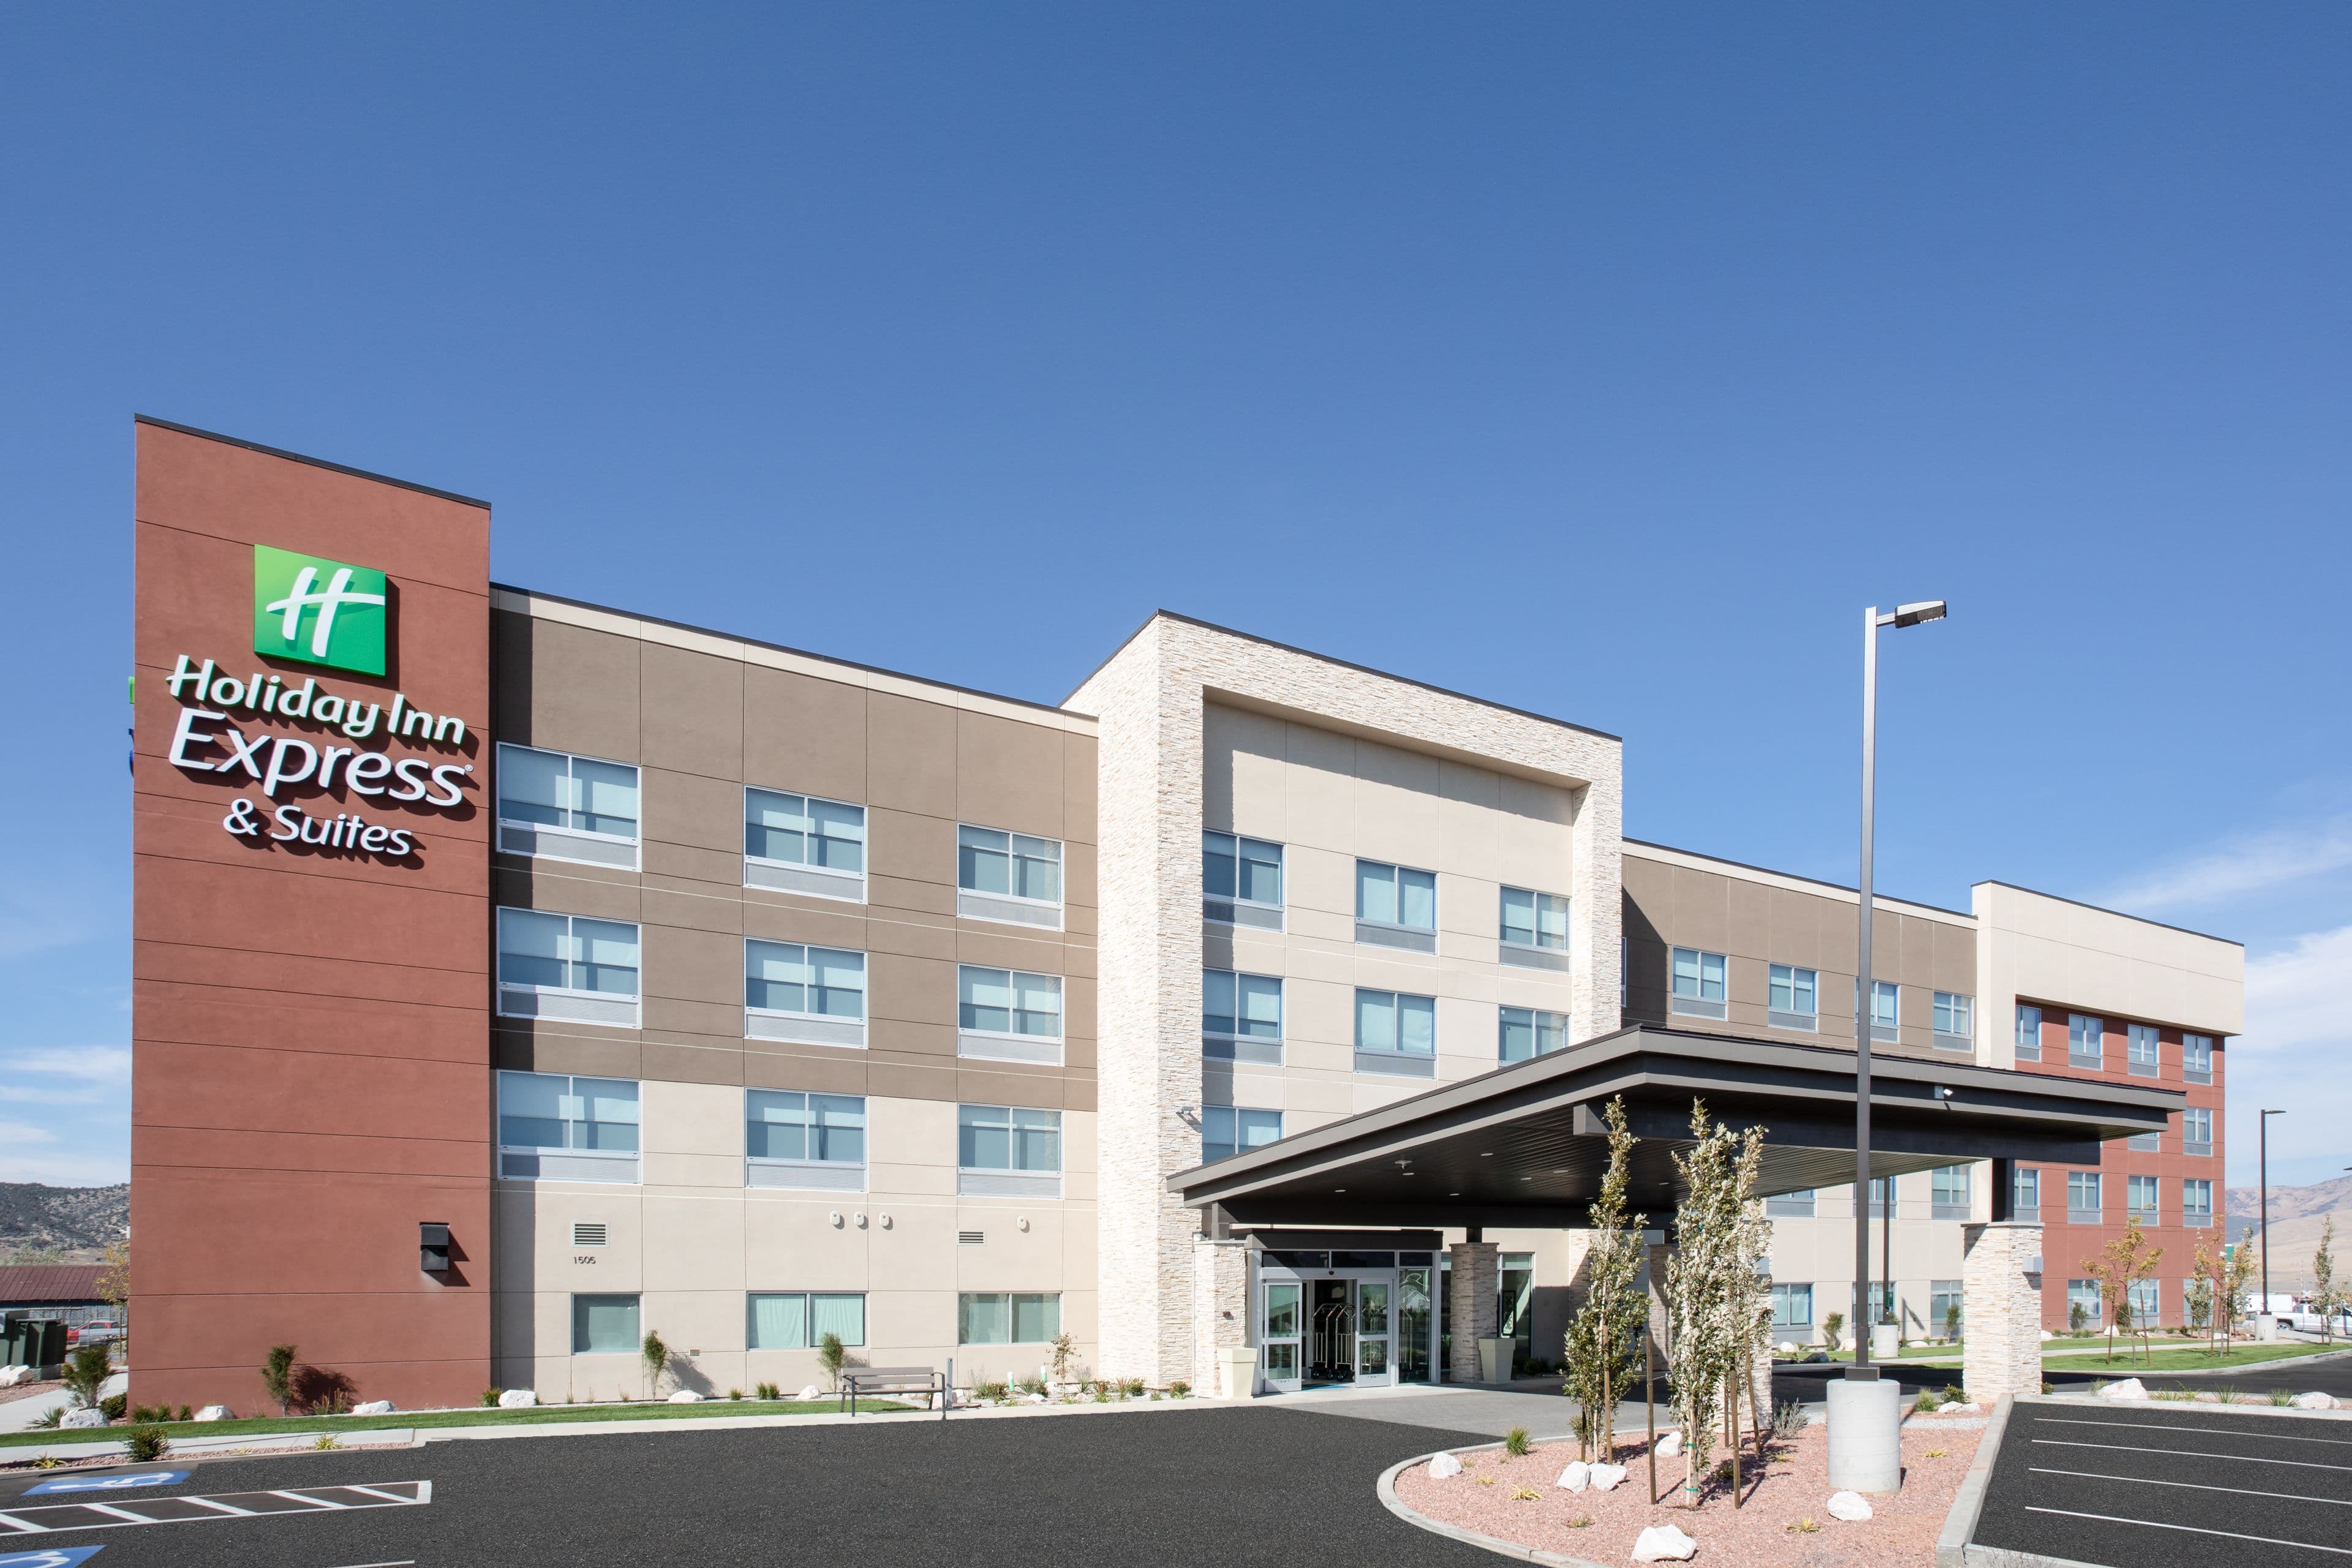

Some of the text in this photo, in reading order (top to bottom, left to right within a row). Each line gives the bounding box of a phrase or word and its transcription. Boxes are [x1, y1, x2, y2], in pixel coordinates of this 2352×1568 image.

[165, 654, 465, 745] Holiday Inn
[222, 798, 412, 855] & Suites
[573, 1256, 596, 1265] 1505
